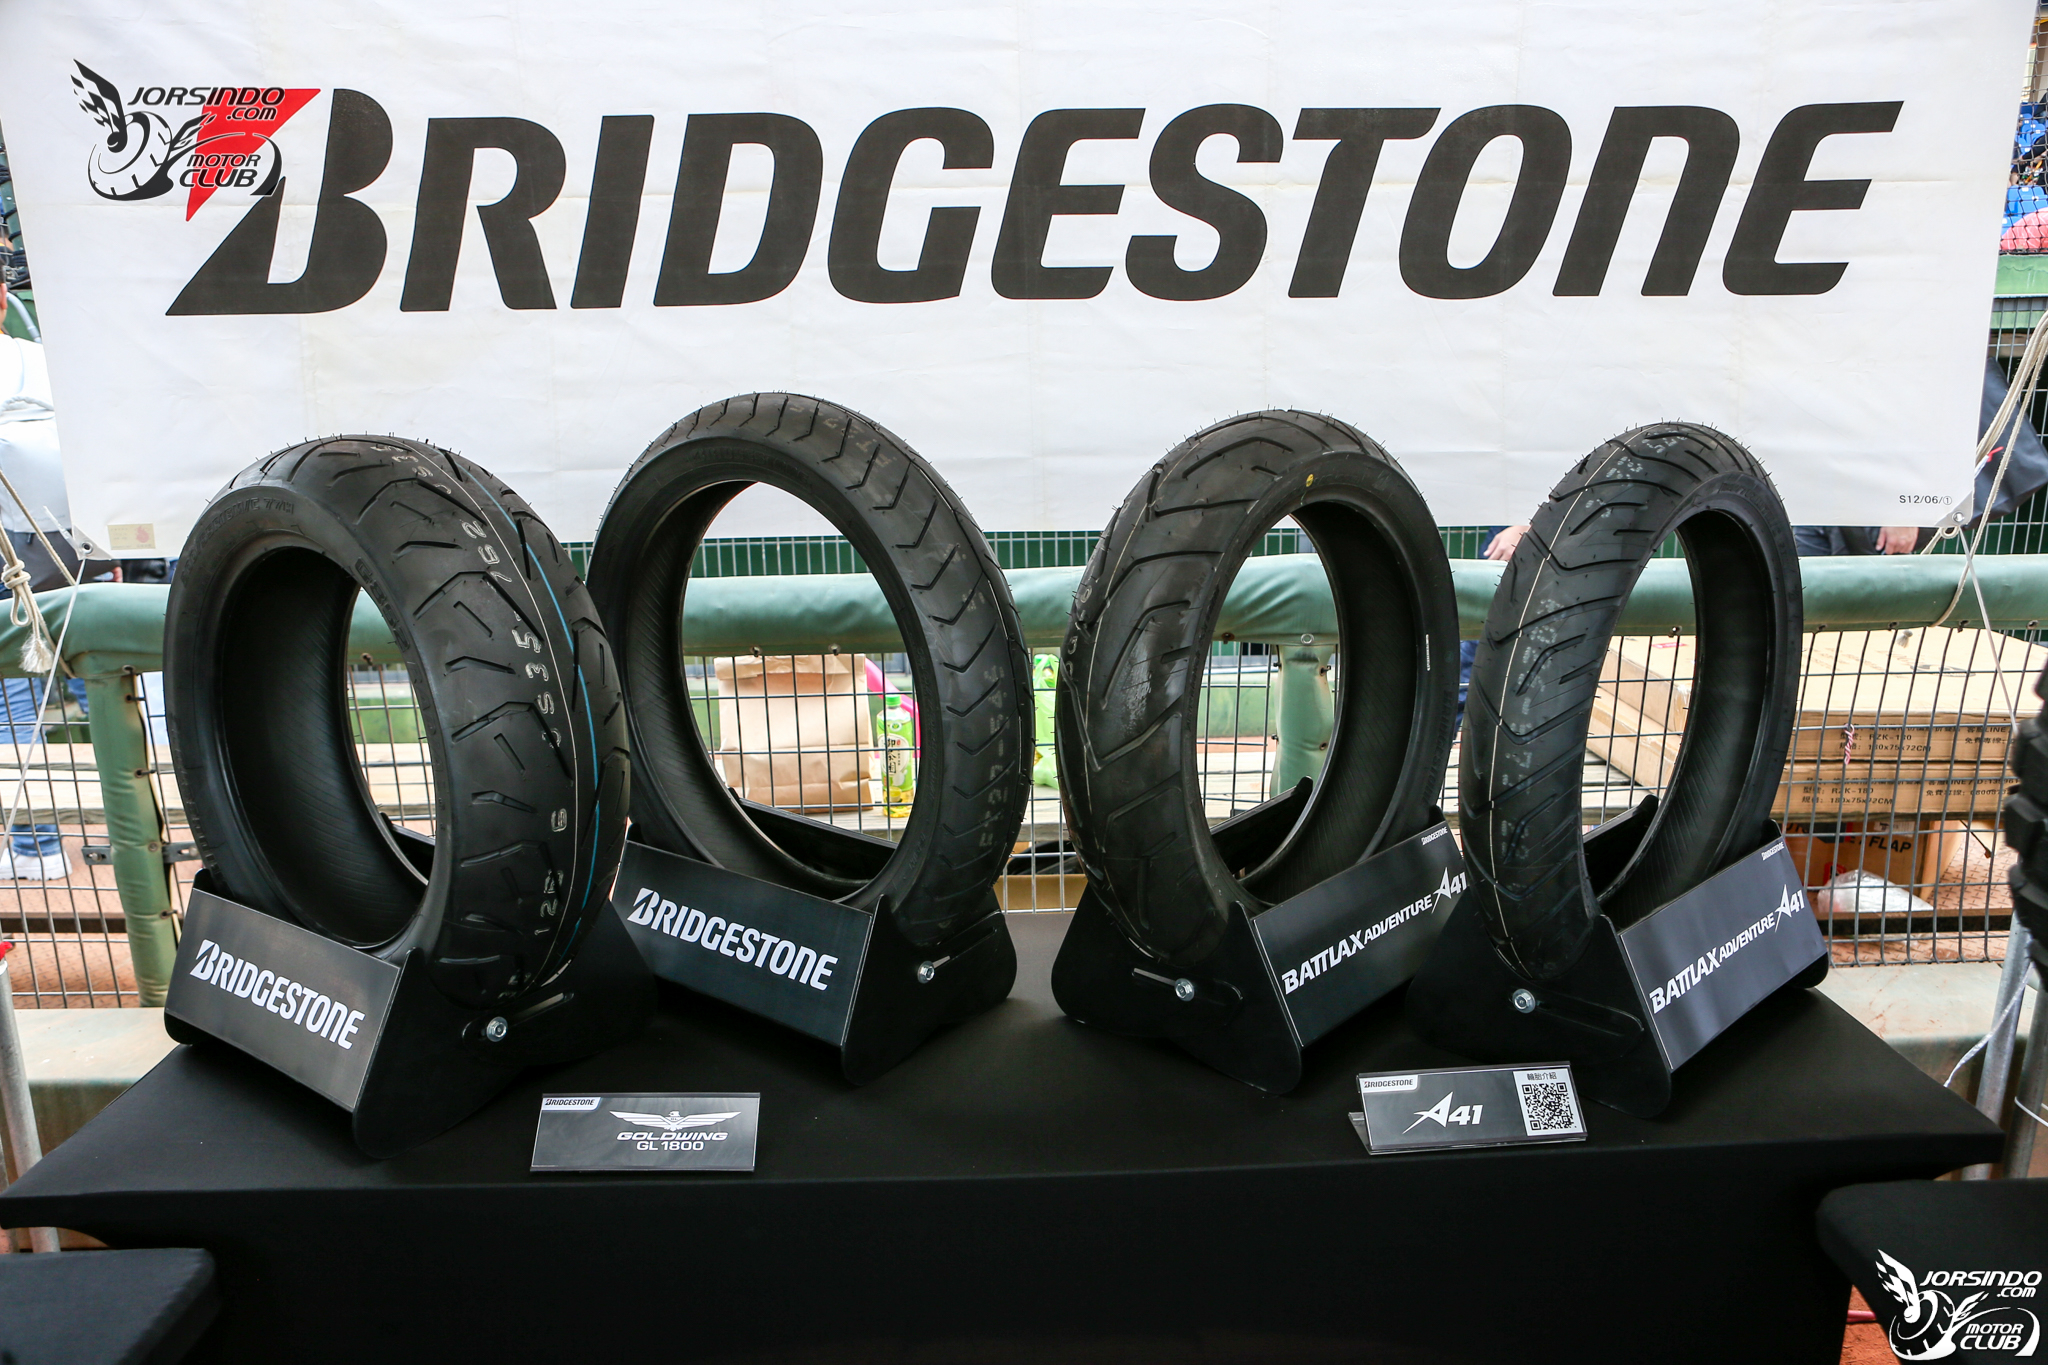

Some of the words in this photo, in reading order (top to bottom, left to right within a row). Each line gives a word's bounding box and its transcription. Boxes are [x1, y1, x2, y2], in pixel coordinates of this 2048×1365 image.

[165, 88, 1904, 316] BRIDGESTONE
[627, 887, 839, 991] BRIDGESTONE
[1281, 930, 1365, 995] BATTLAX
[1364, 894, 1433, 945] ADVENTURE
[1431, 867, 1468, 914] A41
[1649, 947, 1721, 1014] BATTLAX
[1719, 912, 1776, 963] ADVENTURE
[1775, 884, 1805, 933] A41
[189, 939, 366, 1050] BRIDGESTONE
[545, 1098, 595, 1106] BRIDGESTONE
[1363, 1078, 1414, 1089] BRIDGESTONE
[1402, 1091, 1484, 1135] A41
[616, 1131, 729, 1141] GOLDWING
[636, 1141, 659, 1151] GL
[661, 1141, 705, 1151] 1800
